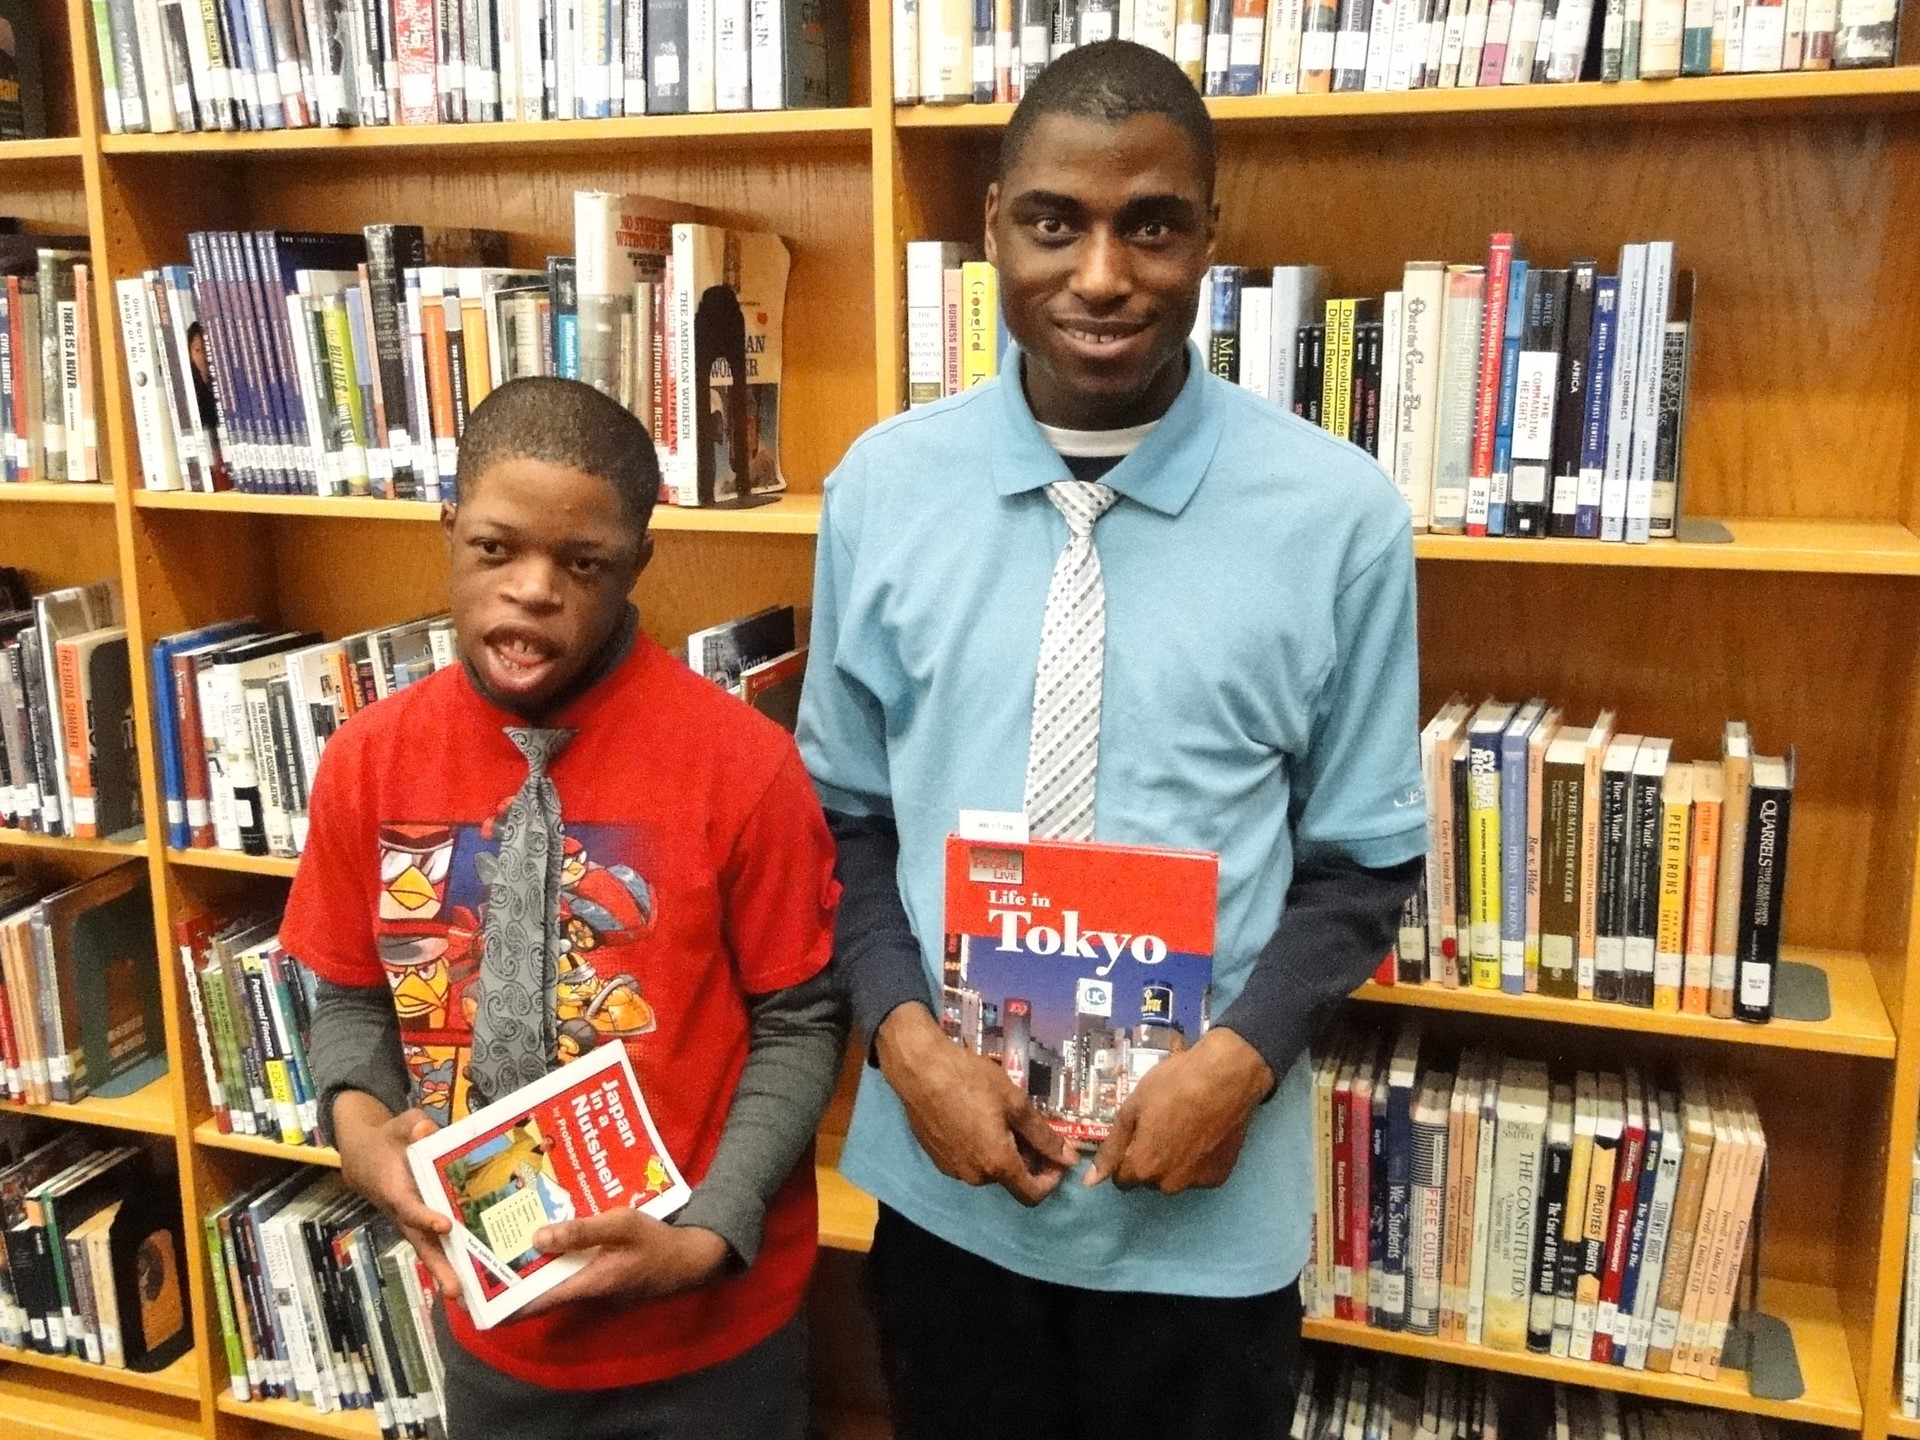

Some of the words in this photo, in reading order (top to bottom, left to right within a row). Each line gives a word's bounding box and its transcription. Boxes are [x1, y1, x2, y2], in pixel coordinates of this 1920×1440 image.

[122, 294, 132, 325] Ready
[132, 298, 141, 319] One
[680, 290, 689, 317] THE
[1655, 277, 1663, 314] CARTOON
[63, 306, 75, 337] THERE
[128, 330, 135, 341] or
[948, 303, 957, 343] BUSINESS
[1326, 308, 1338, 345] Digital
[1340, 309, 1353, 346] Digital
[1488, 301, 1501, 359] WOOLWORTH
[65, 338, 76, 349] IS
[203, 334, 214, 361] STATE
[565, 320, 576, 366] Affirmative
[1598, 323, 1606, 350] AMERICA
[65, 350, 75, 359] A
[130, 346, 138, 363] Not
[680, 320, 690, 384] AMERICAN
[949, 346, 958, 384] BUILDERS
[66, 359, 77, 389] RIVER
[208, 364, 215, 377] OF
[330, 343, 348, 391] BULLIES
[652, 334, 664, 404] Affirmative
[1570, 360, 1581, 393] AFRICA
[211, 381, 219, 398] THE
[1337, 349, 1351, 437] Revolutionaries
[1591, 372, 1604, 420] TWENTY-FIRST
[1620, 370, 1631, 420] ECONOMICS
[1647, 366, 1657, 418] ECONOMICS
[681, 387, 691, 440] WORKER
[1481, 386, 1493, 426] AMERICAN
[1517, 380, 1529, 429] HEIGHTS
[1528, 371, 1542, 440] COMMANDING
[1541, 394, 1550, 418] THE
[1667, 397, 1680, 412] OF
[1479, 428, 1489, 451] FIVE
[1589, 423, 1600, 450] CENTURY
[436, 634, 446, 653] THE
[60, 649, 74, 698] FREEDOM
[257, 701, 268, 716] THE
[66, 702, 78, 749] SUMMER
[259, 718, 270, 743] ORDEAL
[261, 744, 273, 755] OF
[264, 755, 281, 807] ASSIMILATION
[1471, 747, 1484, 810] RIGHTS
[1483, 749, 1496, 809] CYBER
[1568, 781, 1578, 792] IN
[1612, 781, 1624, 800] Roe
[1567, 794, 1578, 815] THE
[1612, 803, 1620, 811] v.
[1645, 786, 1656, 805] Roe
[1644, 808, 1652, 816] v.
[1441, 820, 1451, 841] Clay
[1565, 816, 1576, 857] MATTER
[1611, 813, 1623, 842] Wade
[1643, 818, 1655, 847] Wade
[1667, 814, 1681, 855] PETER
[1758, 799, 1777, 866] QUARRELS
[1528, 837, 1539, 854] Roe
[973, 857, 1019, 871] PEOPLE
[994, 870, 1017, 880] LIVE
[1442, 851, 1451, 881] United
[1565, 858, 1575, 869] OF
[1664, 858, 1678, 895] IRONS
[1443, 884, 1452, 906] States
[1528, 869, 1539, 896] Wade
[1563, 870, 1574, 902] COLOR
[988, 890, 1025, 907] Life
[1032, 892, 1050, 907] in
[1508, 886, 1518, 933] FERGUSON
[988, 909, 1167, 976] Tokyo
[251, 978, 268, 1020] Personal
[260, 1020, 274, 1057] Finance
[590, 1089, 604, 1108] in
[598, 1114, 609, 1127] a
[602, 1079, 637, 1148] Japan
[557, 1117, 582, 1170] Professor
[1076, 1126, 1085, 1134] A.
[1504, 1130, 1533, 1140] SMITH
[571, 1094, 624, 1199] Nutshell
[1337, 1161, 1346, 1185] RACIAL
[1519, 1151, 1534, 1182] THE
[1390, 1185, 1405, 1202] We
[1424, 1188, 1439, 1226] FREE
[1337, 1186, 1346, 1240] DISCRIMINATION
[1549, 1202, 1561, 1215] The
[1590, 1184, 1607, 1233] EMPLOYEES
[1638, 1202, 1648, 1215] The
[1702, 1208, 1715, 1234] Ferrell
[1387, 1213, 1404, 1259] Students
[1547, 1217, 1559, 1235] Case
[1633, 1218, 1645, 1239] Right
[1718, 1210, 1732, 1236] Ferrell
[1493, 1229, 1504, 1254] History
[1510, 1186, 1532, 1302] CONSTITUTION
[1544, 1246, 1557, 1262] ROE
[1546, 1236, 1557, 1245] of
[1610, 1221, 1627, 1271] ENVIRONMENT
[1632, 1241, 1642, 1249] to
[1645, 1240, 1662, 1264] RIGHTS
[1585, 1240, 1600, 1270] RIGHTS
[1629, 1251, 1639, 1265] Die
[1696, 1244, 1708, 1269] Dallas
[1711, 1247, 1725, 1272] Dallas
[1540, 1270, 1553, 1293] WADE
[1723, 1262, 1740, 1296] Missouri
